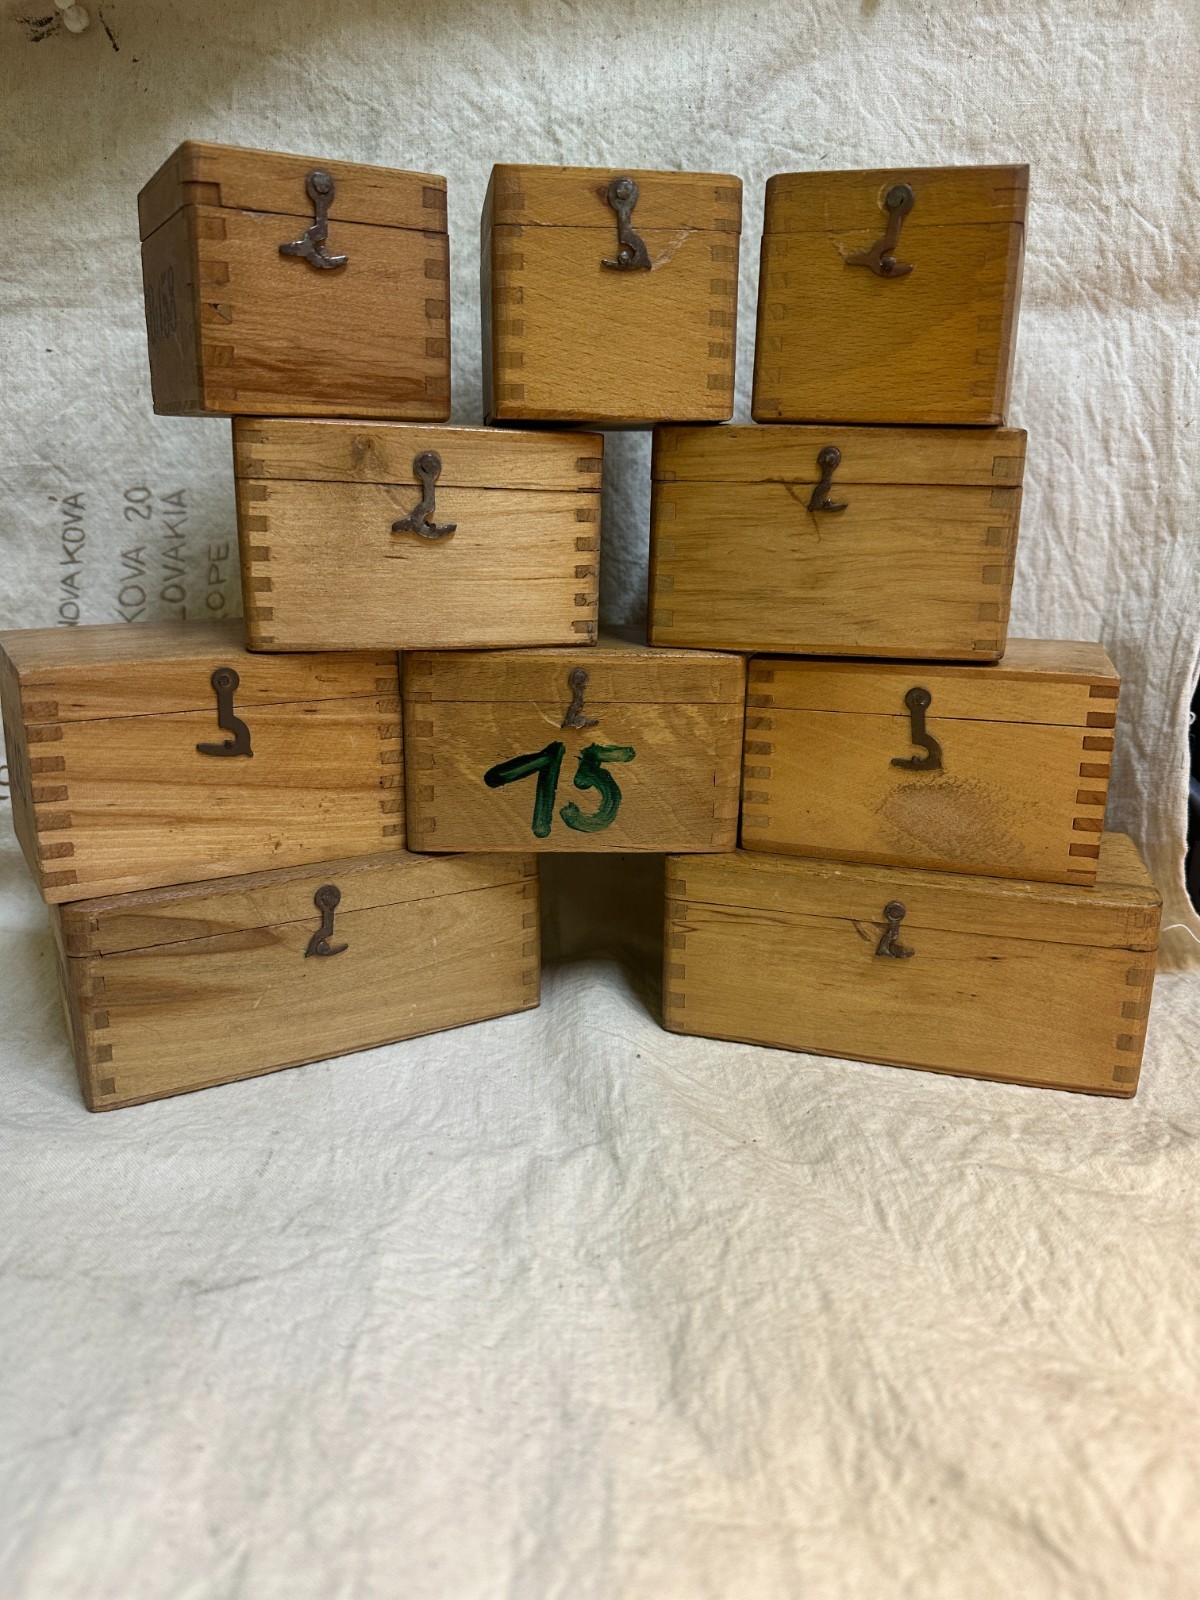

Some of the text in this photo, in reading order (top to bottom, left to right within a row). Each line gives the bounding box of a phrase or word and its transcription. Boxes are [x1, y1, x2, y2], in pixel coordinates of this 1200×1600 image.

[123, 485, 153, 522] 20
[205, 541, 230, 618] OPE
[484, 741, 636, 838] 15
